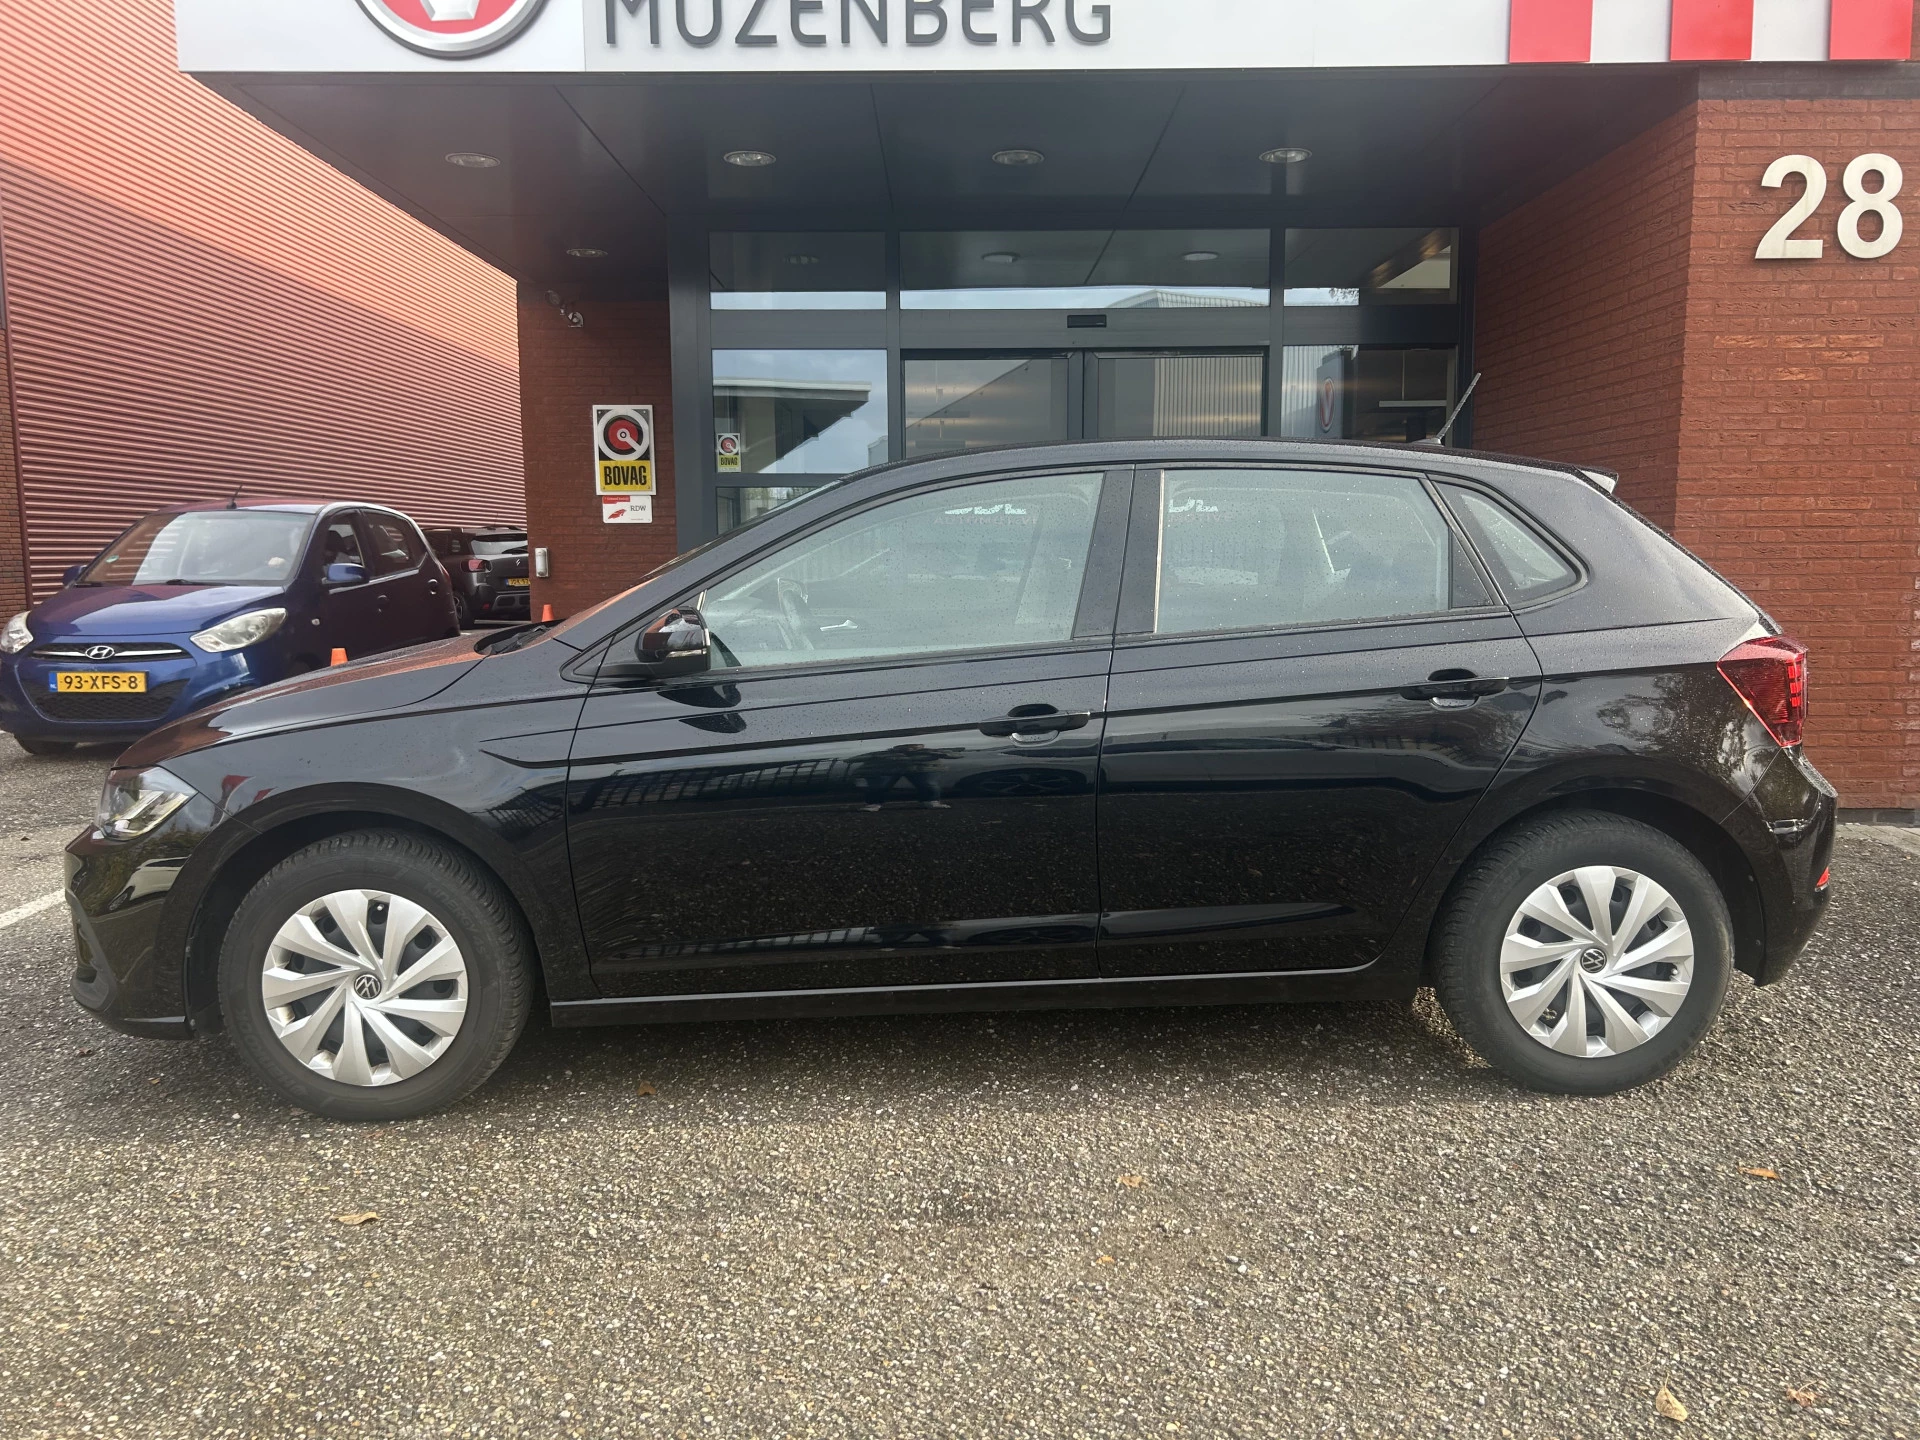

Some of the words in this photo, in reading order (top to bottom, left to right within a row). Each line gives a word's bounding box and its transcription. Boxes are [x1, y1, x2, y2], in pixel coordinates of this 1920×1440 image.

[1754, 152, 1905, 260] 28
[720, 456, 739, 466] BOVAG
[603, 465, 648, 486] BOVAG
[63, 674, 139, 690] 93-XFS-8
